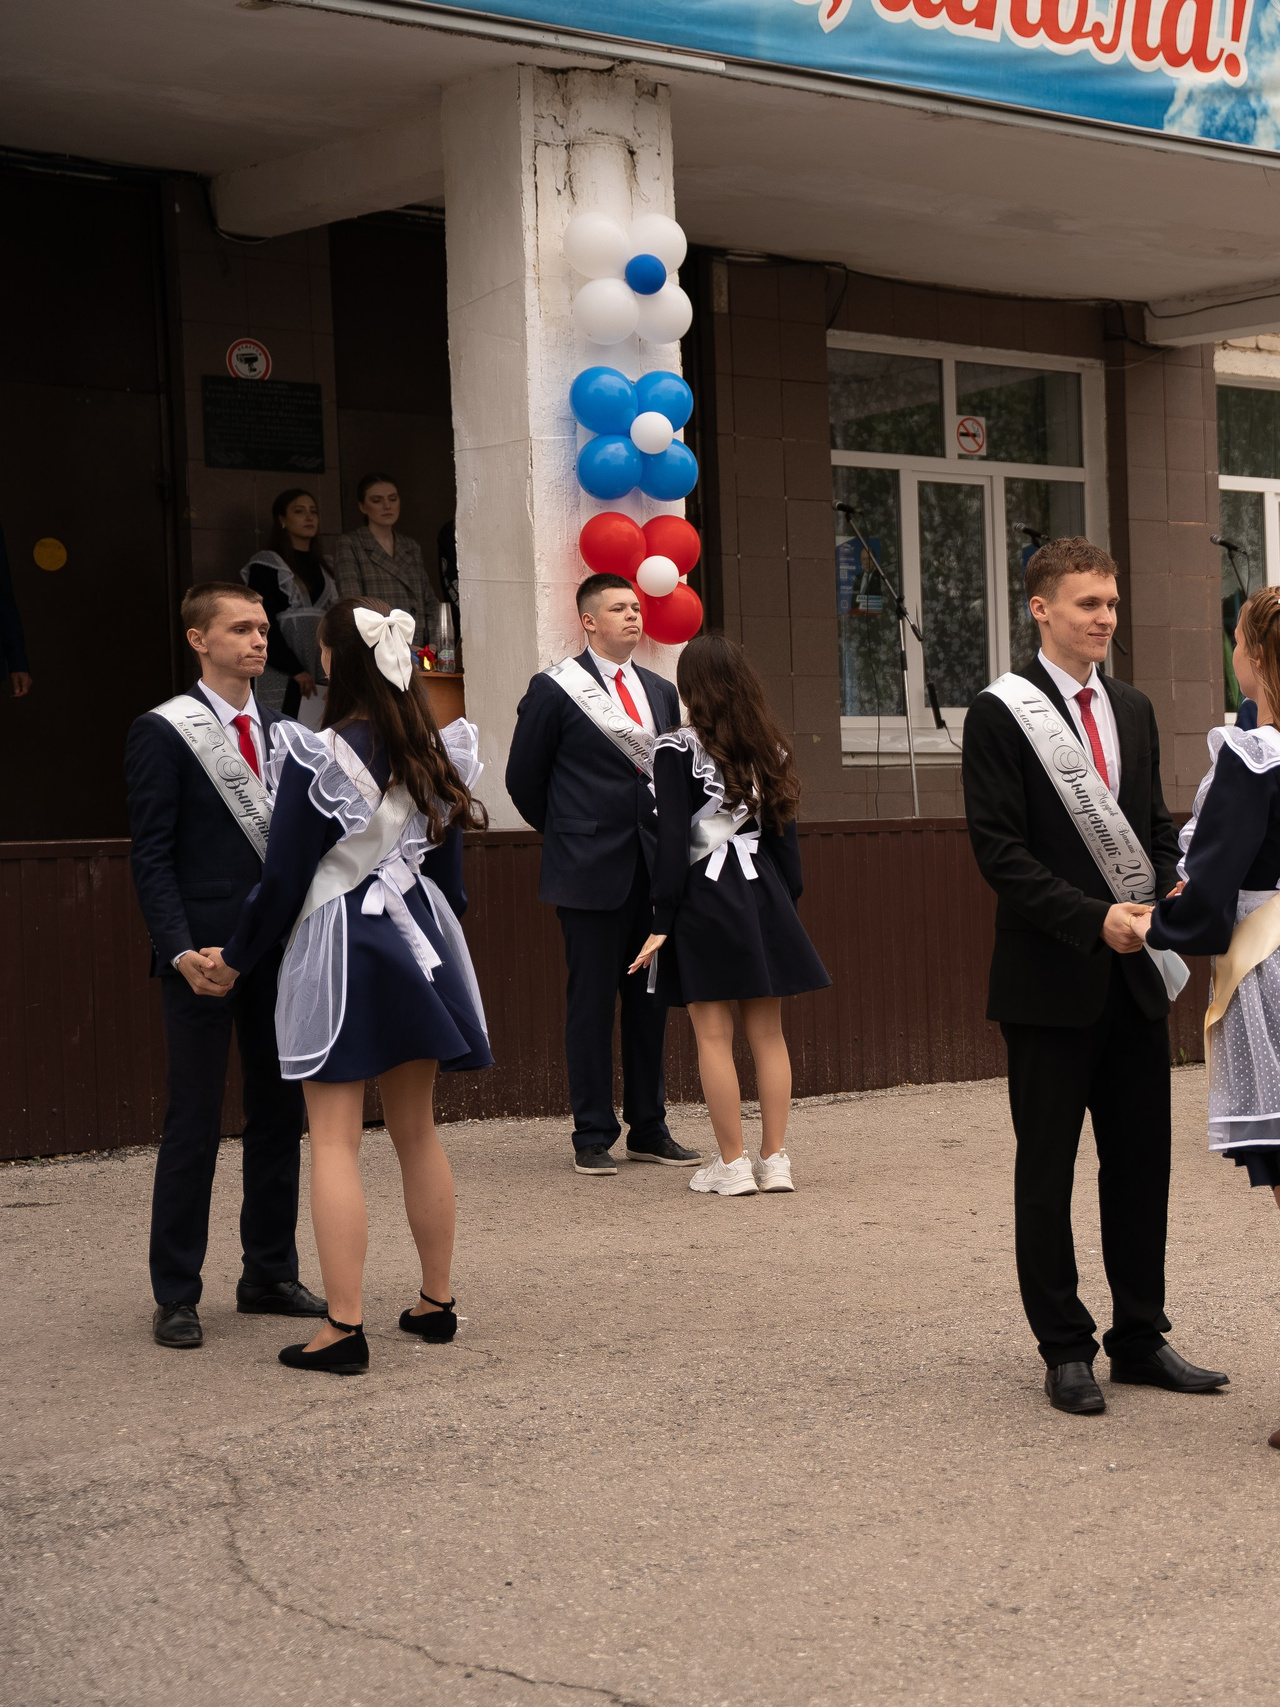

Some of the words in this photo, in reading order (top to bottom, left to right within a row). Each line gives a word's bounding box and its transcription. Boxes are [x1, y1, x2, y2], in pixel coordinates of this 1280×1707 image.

[876, 0, 1246, 82] ола!
[1014, 706, 1036, 732] класс
[215, 755, 270, 844] Выпускн
[1053, 744, 1121, 858] Выпускник
